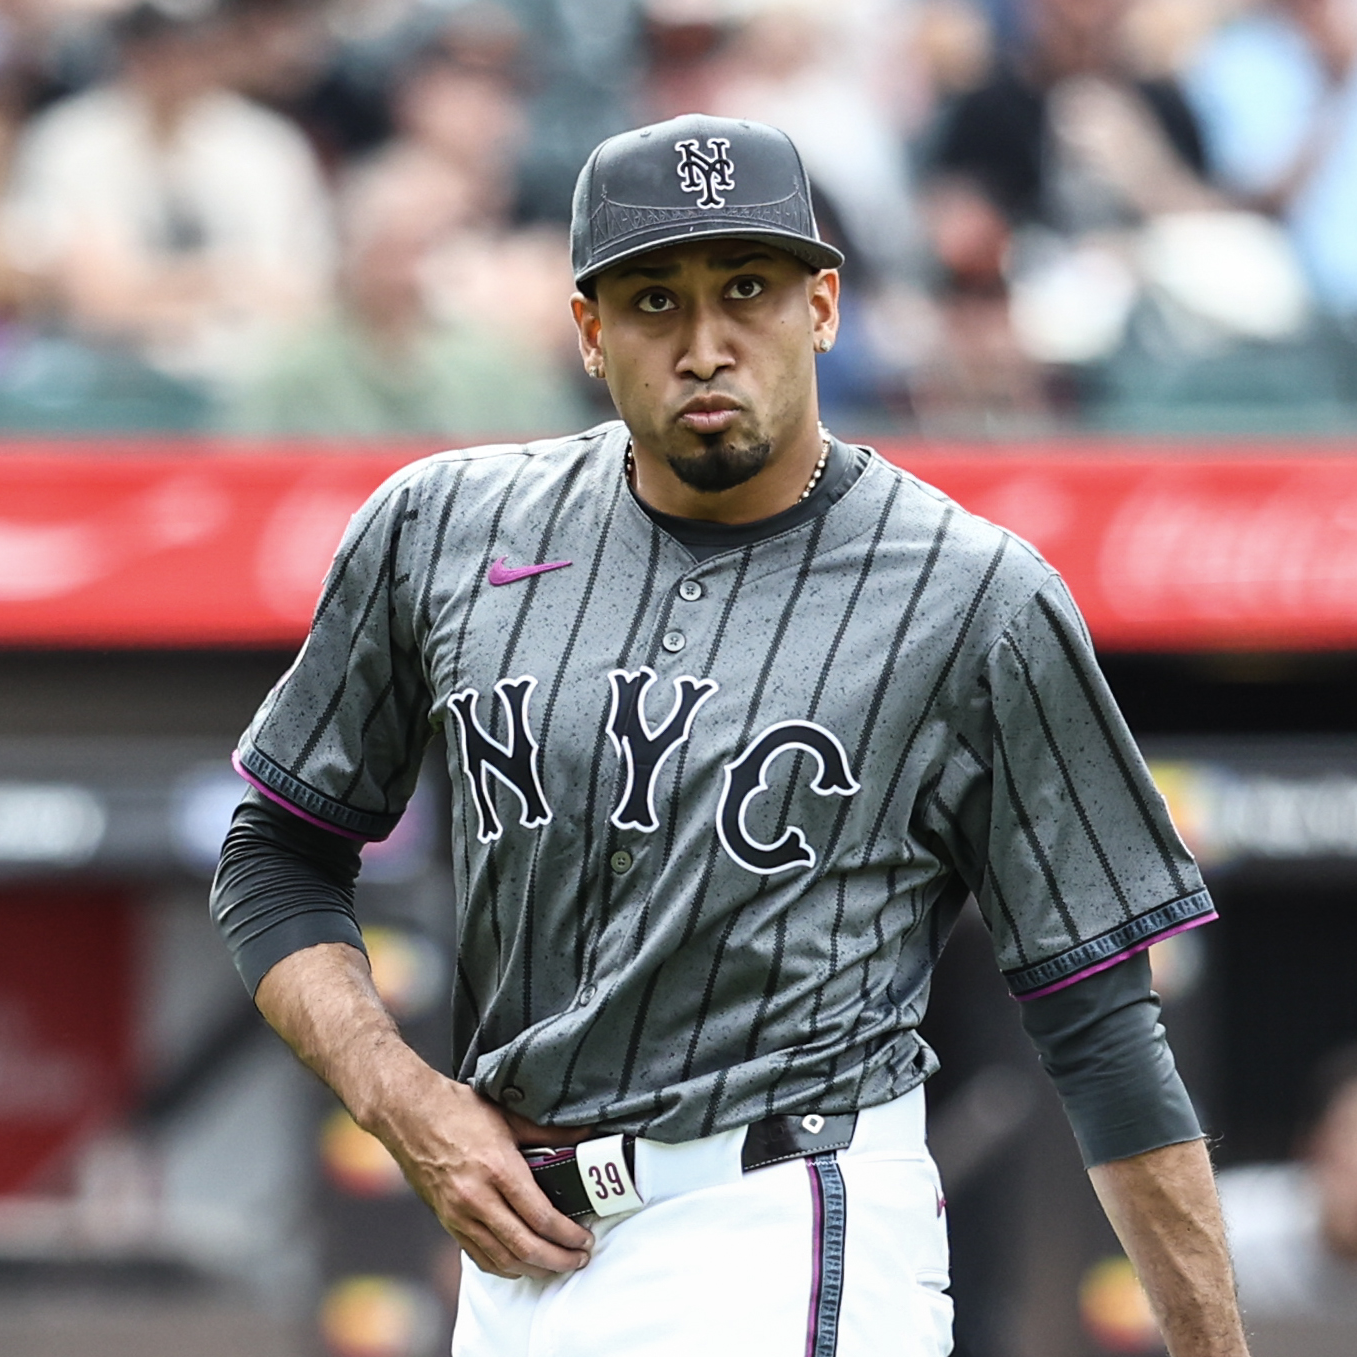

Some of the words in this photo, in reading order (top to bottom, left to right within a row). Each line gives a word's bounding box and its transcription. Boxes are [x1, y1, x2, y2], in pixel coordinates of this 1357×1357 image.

[675, 138, 734, 209] NY
[448, 667, 860, 875] NYC
[589, 1162, 625, 1200] 39
